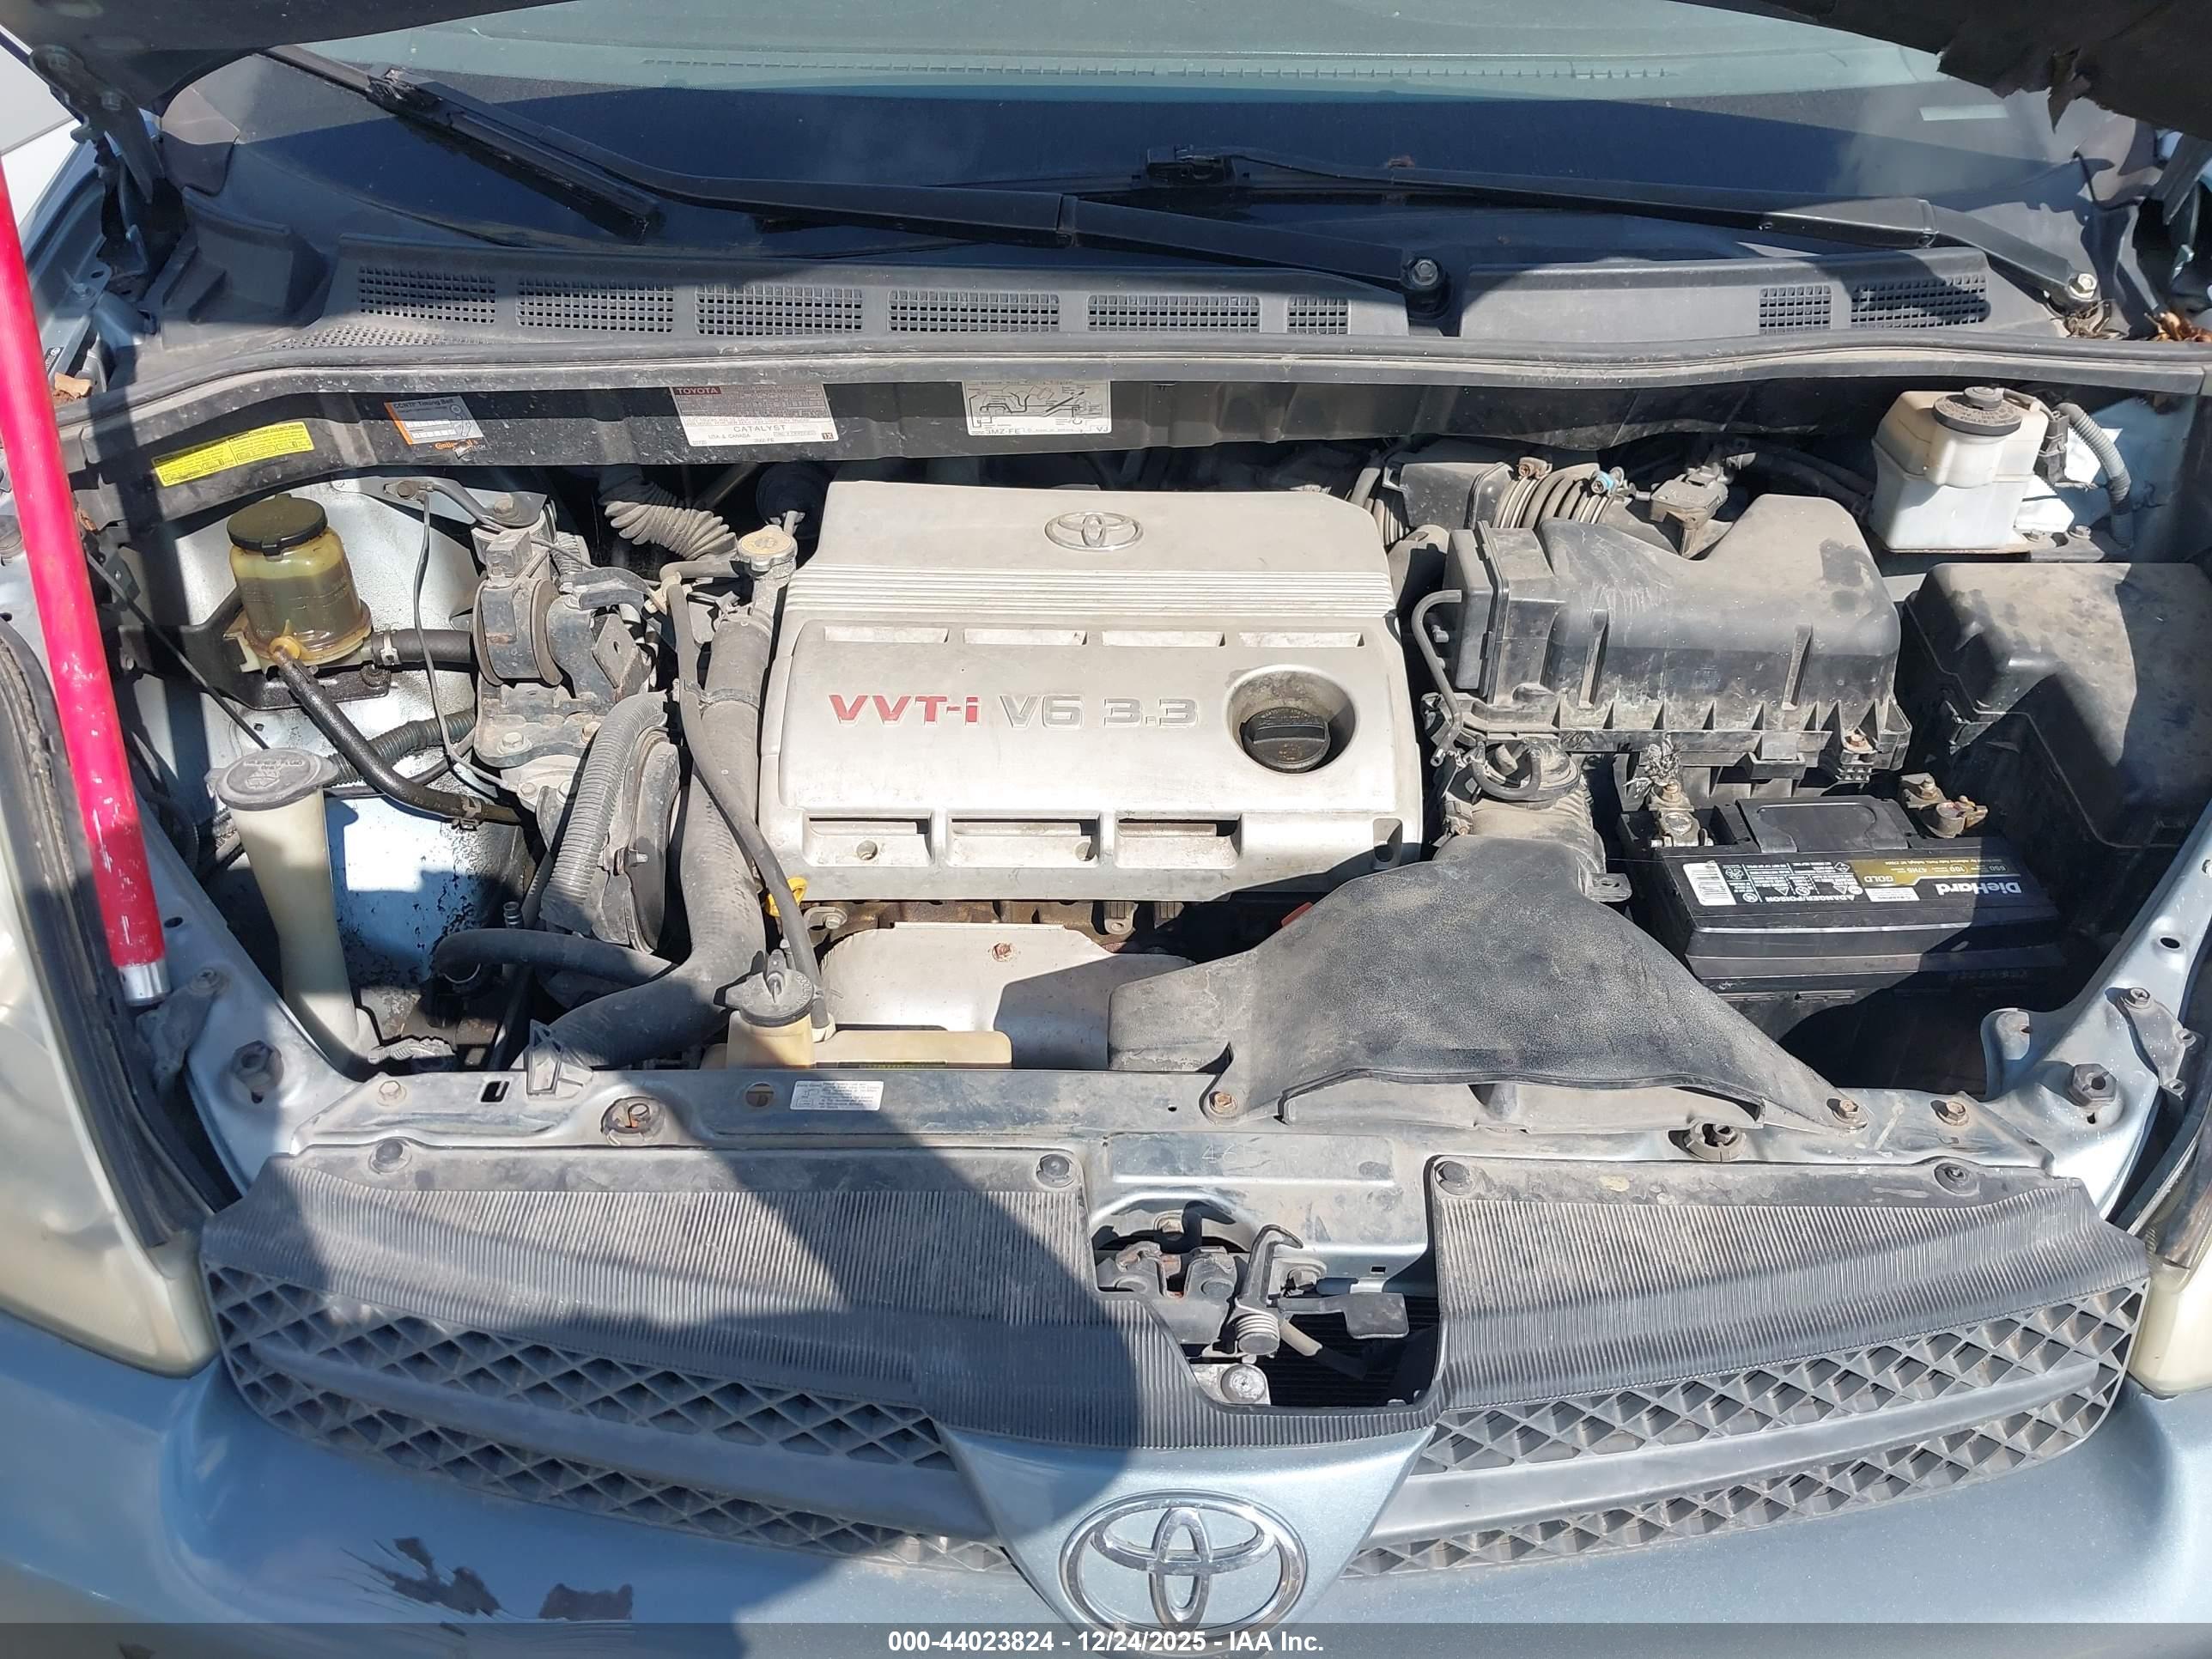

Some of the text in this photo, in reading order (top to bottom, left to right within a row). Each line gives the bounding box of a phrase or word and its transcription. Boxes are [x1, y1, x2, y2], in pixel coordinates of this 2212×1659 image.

[733, 424, 787, 433] CATALYST
[829, 694, 1200, 728] VVT-i V6 3.3
[1936, 882, 2022, 895] DieHard
